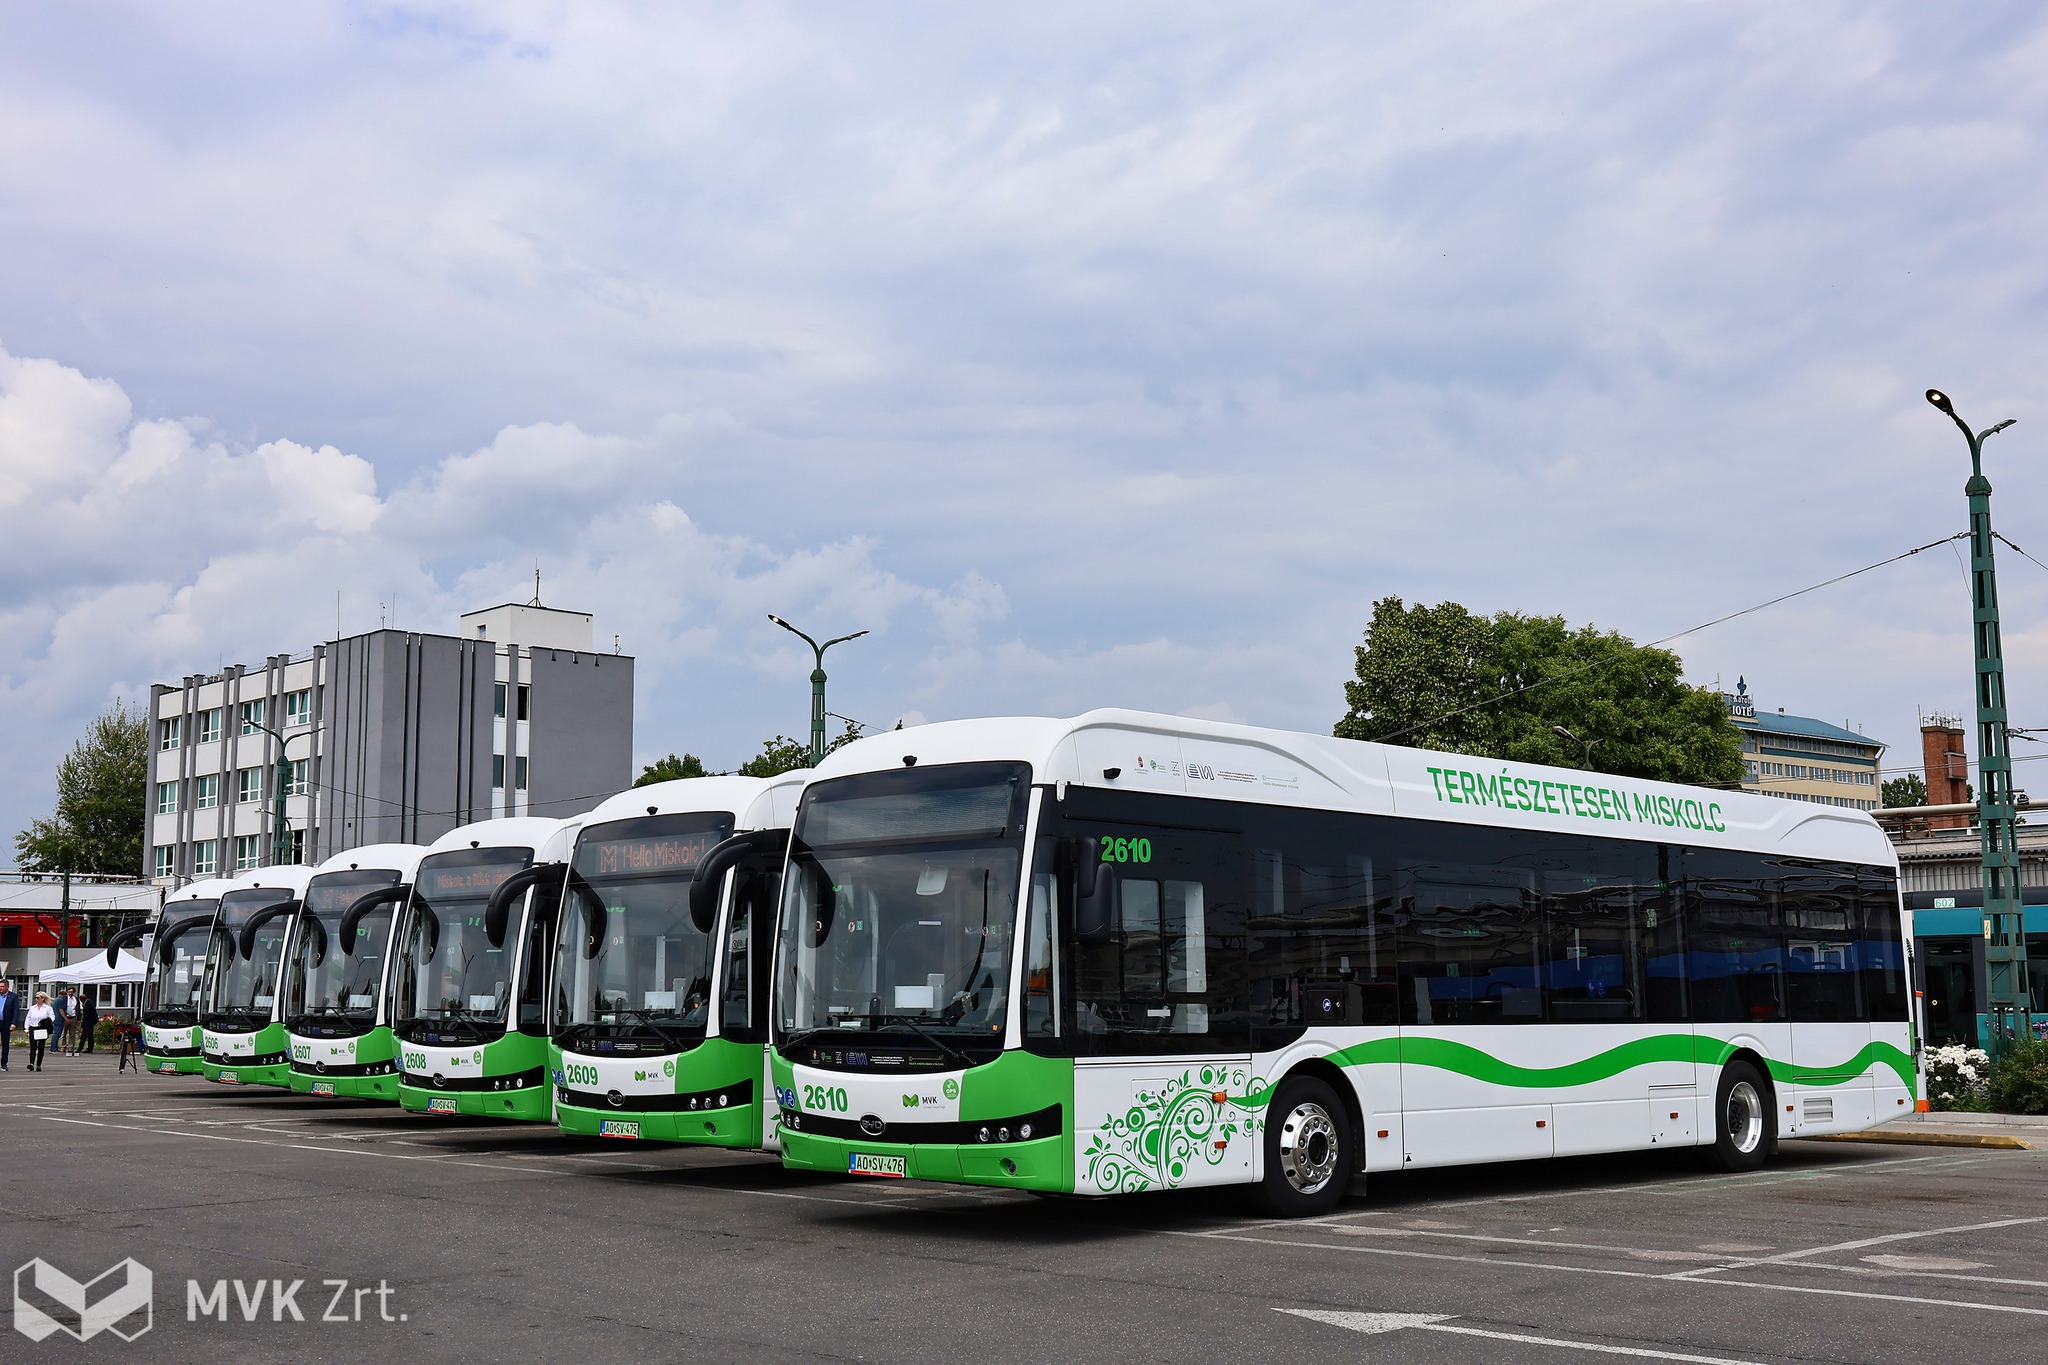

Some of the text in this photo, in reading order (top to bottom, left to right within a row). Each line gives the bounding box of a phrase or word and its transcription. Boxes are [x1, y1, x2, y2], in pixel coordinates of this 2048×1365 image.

[1426, 767, 1726, 833] TERMÉSZETESEN MISKOLC
[623, 844, 652, 869] Hello
[1101, 836, 1152, 863] 2610
[1935, 898, 1954, 908] 602
[146, 1031, 159, 1043] 2605
[204, 1036, 219, 1050] 2606
[293, 1045, 311, 1060] 2607
[404, 1052, 427, 1070] 2608
[566, 1064, 599, 1086] 2609
[803, 1084, 848, 1112] 2610
[922, 1096, 938, 1105] MVK
[861, 1119, 883, 1130] BYD
